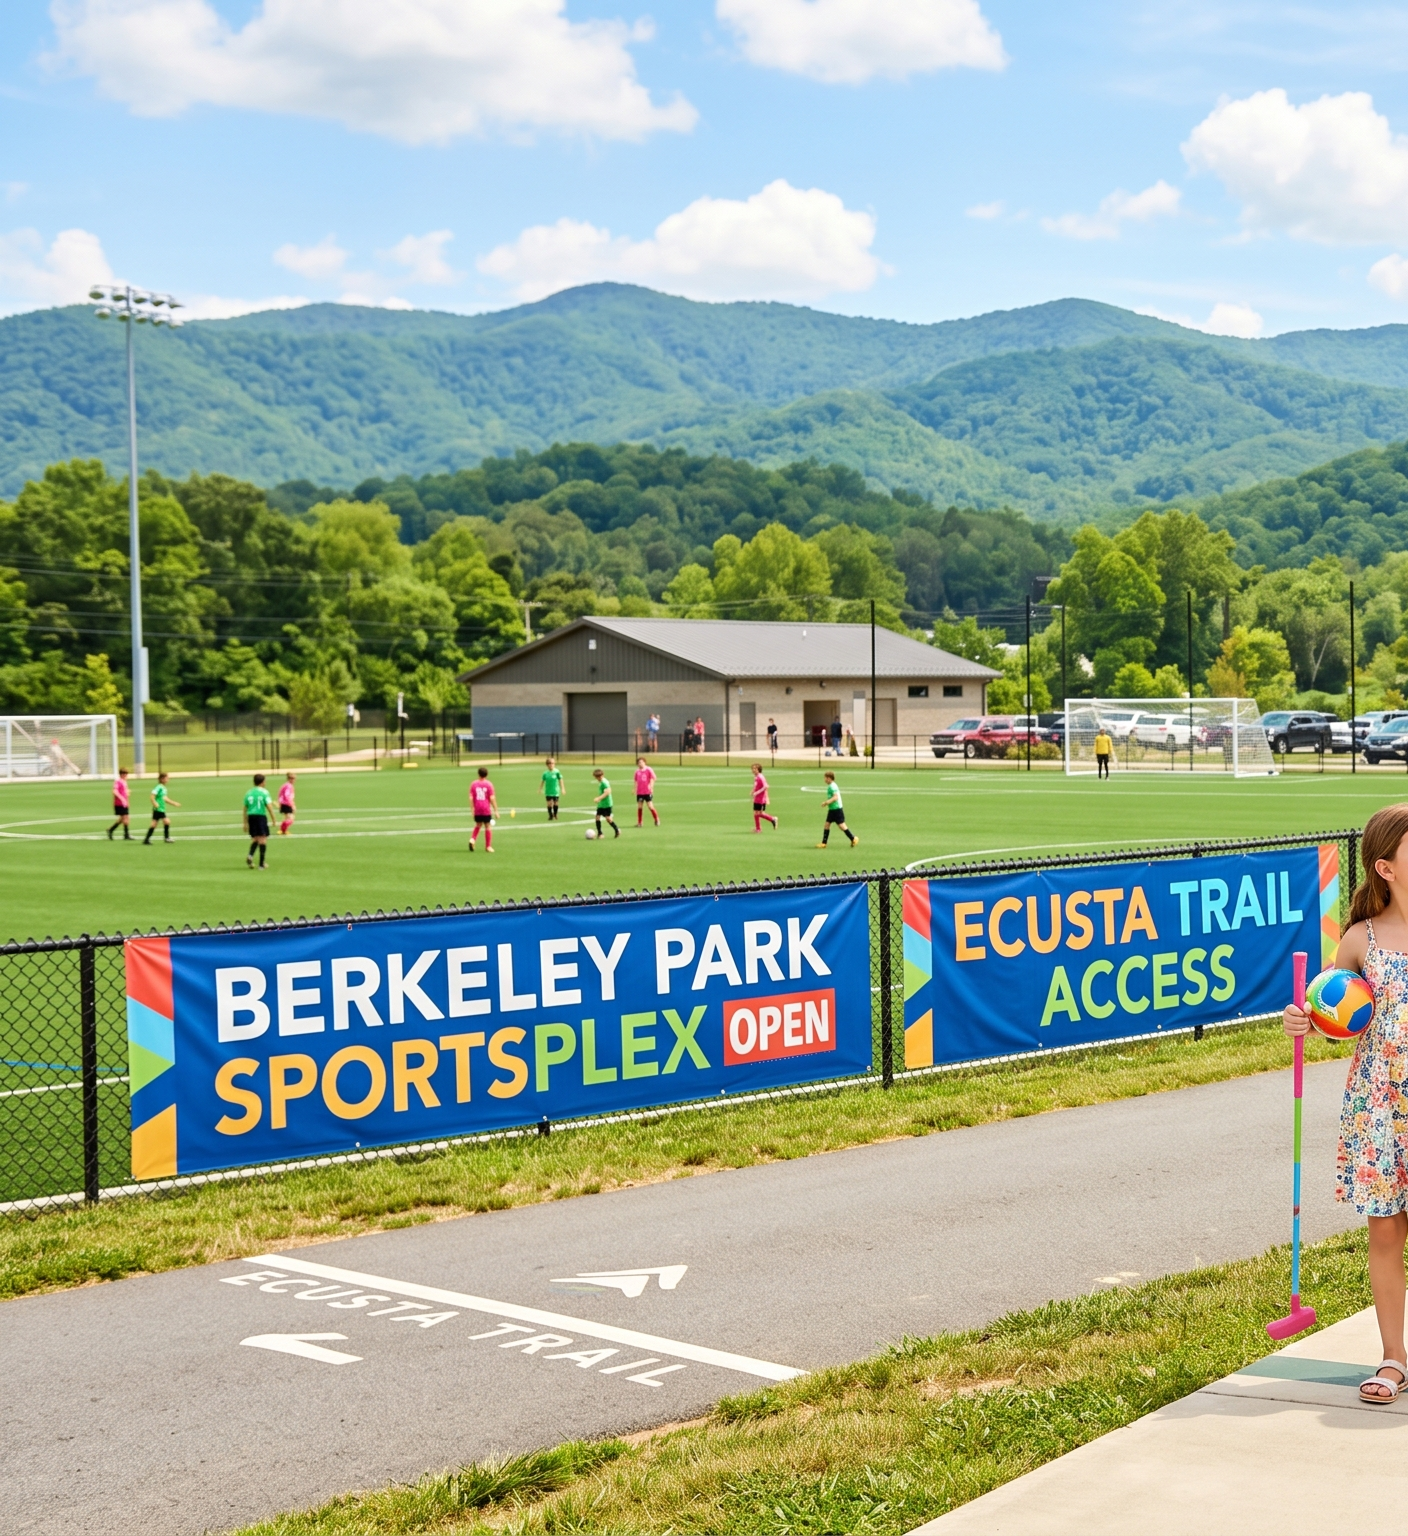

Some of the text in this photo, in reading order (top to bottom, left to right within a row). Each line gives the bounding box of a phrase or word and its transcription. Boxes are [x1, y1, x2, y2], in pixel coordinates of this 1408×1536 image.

[953, 870, 1304, 962] ECUSTA TRAIL
[215, 913, 832, 1044] BERKELEY PARK
[728, 998, 830, 1056] OPEN
[1039, 943, 1236, 1027] ACCESS
[213, 1004, 712, 1137] SPORTSPLEX
[217, 1269, 689, 1389] ECUSTA TRAIL
